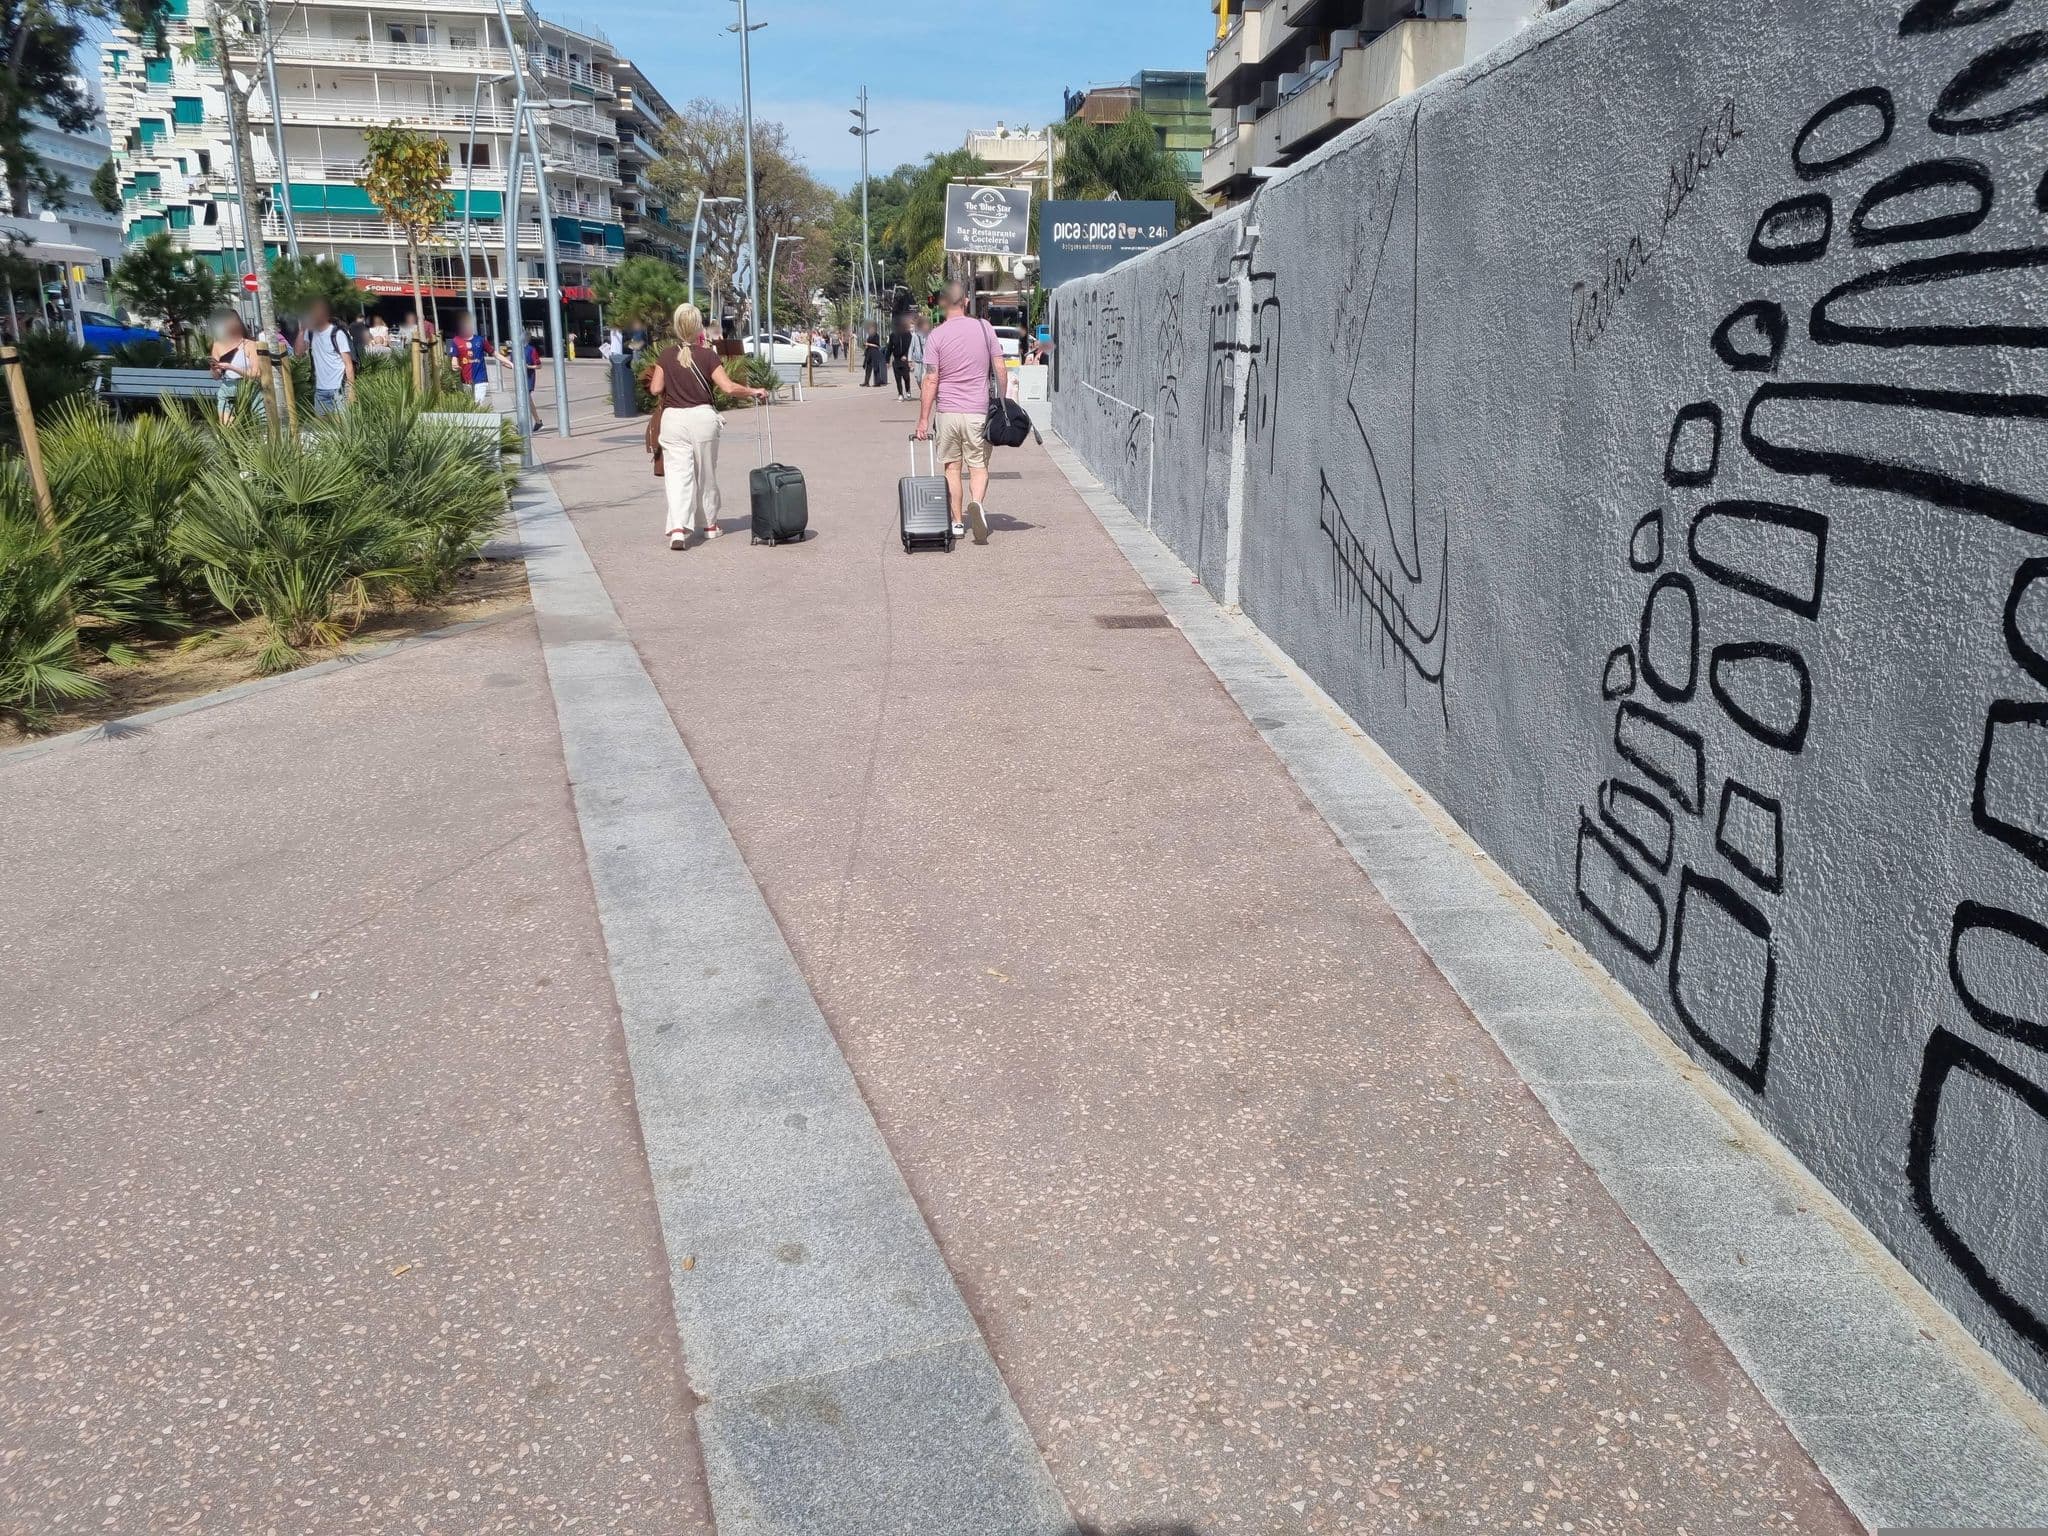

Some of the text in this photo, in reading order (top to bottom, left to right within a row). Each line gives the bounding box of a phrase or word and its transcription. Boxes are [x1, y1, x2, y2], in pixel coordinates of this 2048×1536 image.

[964, 201, 978, 210] The
[979, 202, 996, 212] Blue
[996, 204, 1012, 213] Star
[956, 226, 1017, 238] Bar Restaurante
[963, 234, 970, 242] &
[1148, 225, 1169, 239] 24h
